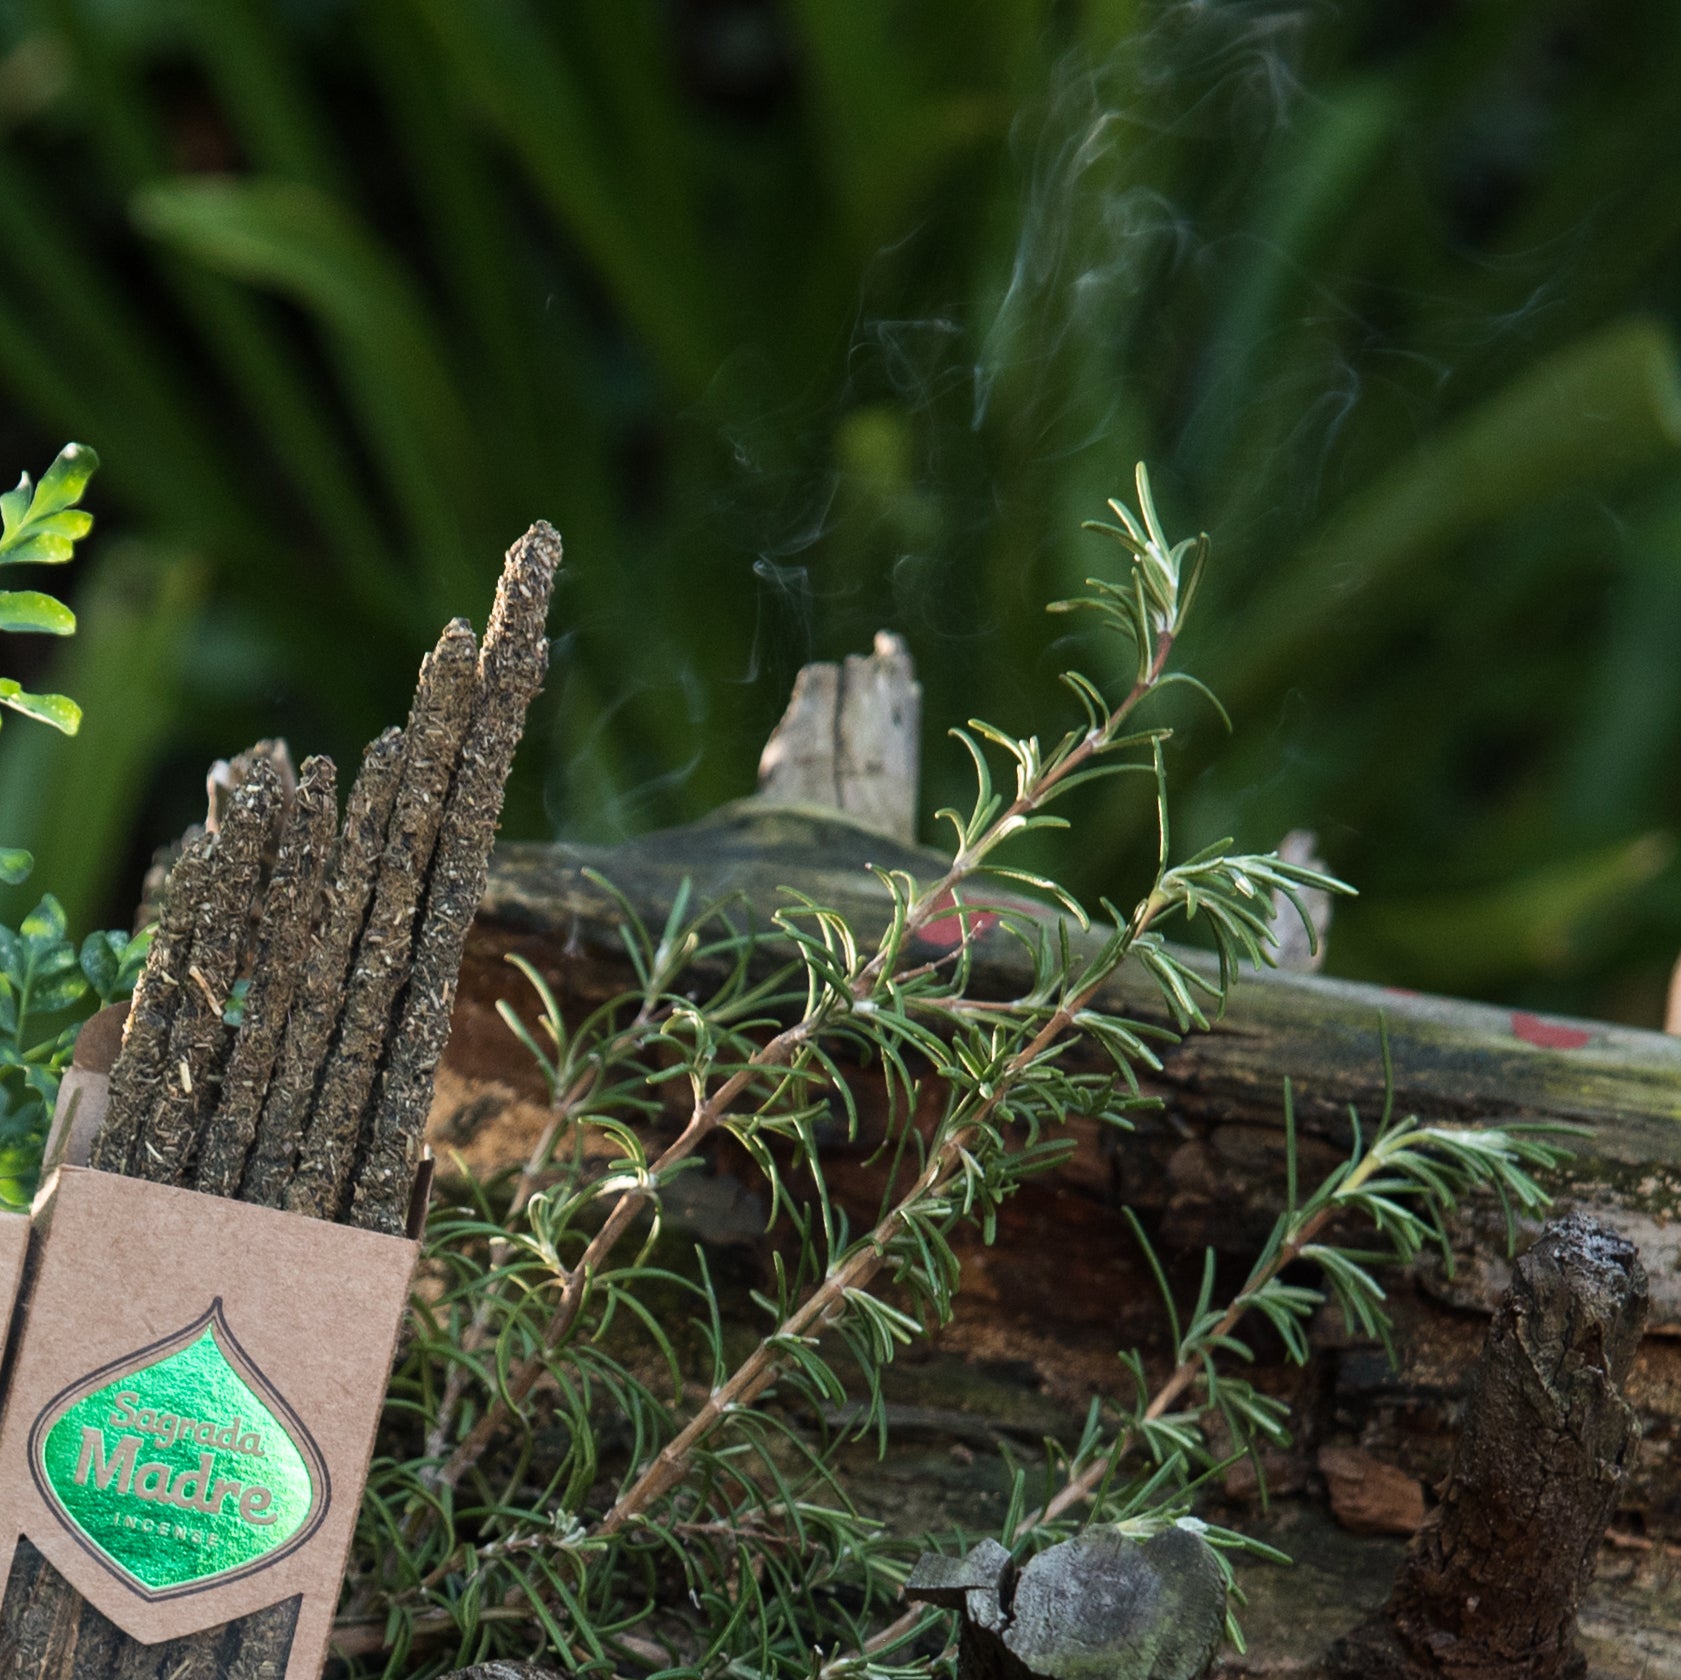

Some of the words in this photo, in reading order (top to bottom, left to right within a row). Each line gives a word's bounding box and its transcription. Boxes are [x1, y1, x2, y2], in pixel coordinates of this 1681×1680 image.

[108, 1390, 265, 1457] Sagrada
[74, 1426, 278, 1526] Madre
[113, 1512, 220, 1547] INCENSE
